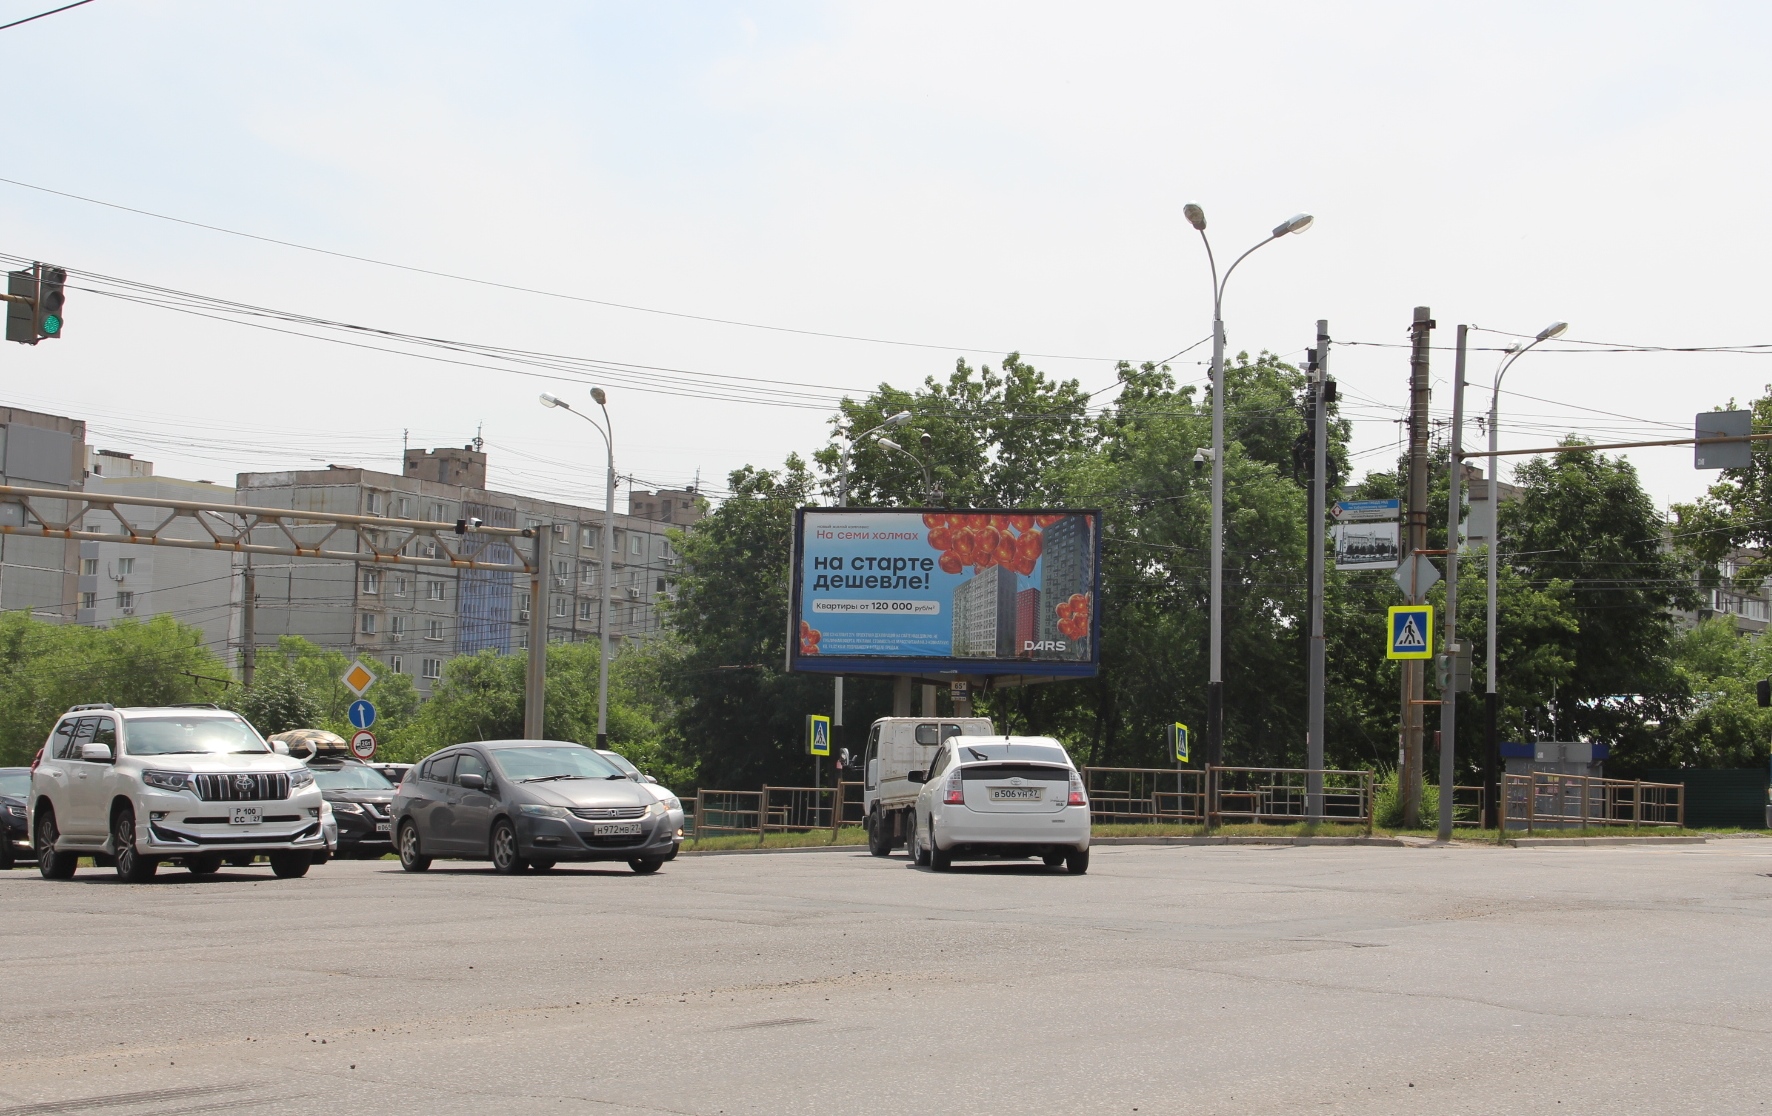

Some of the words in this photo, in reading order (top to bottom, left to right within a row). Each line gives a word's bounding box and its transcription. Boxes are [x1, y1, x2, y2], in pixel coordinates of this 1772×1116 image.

[816, 530, 834, 540] На
[837, 531, 869, 540] семи
[872, 532, 918, 540] холмах
[814, 556, 843, 570] на
[851, 556, 934, 576] старте
[813, 573, 930, 591] дешевле!
[816, 603, 858, 611] Квартиры
[871, 602, 889, 610] 120
[891, 602, 913, 611] 000
[1024, 641, 1066, 651] DARS
